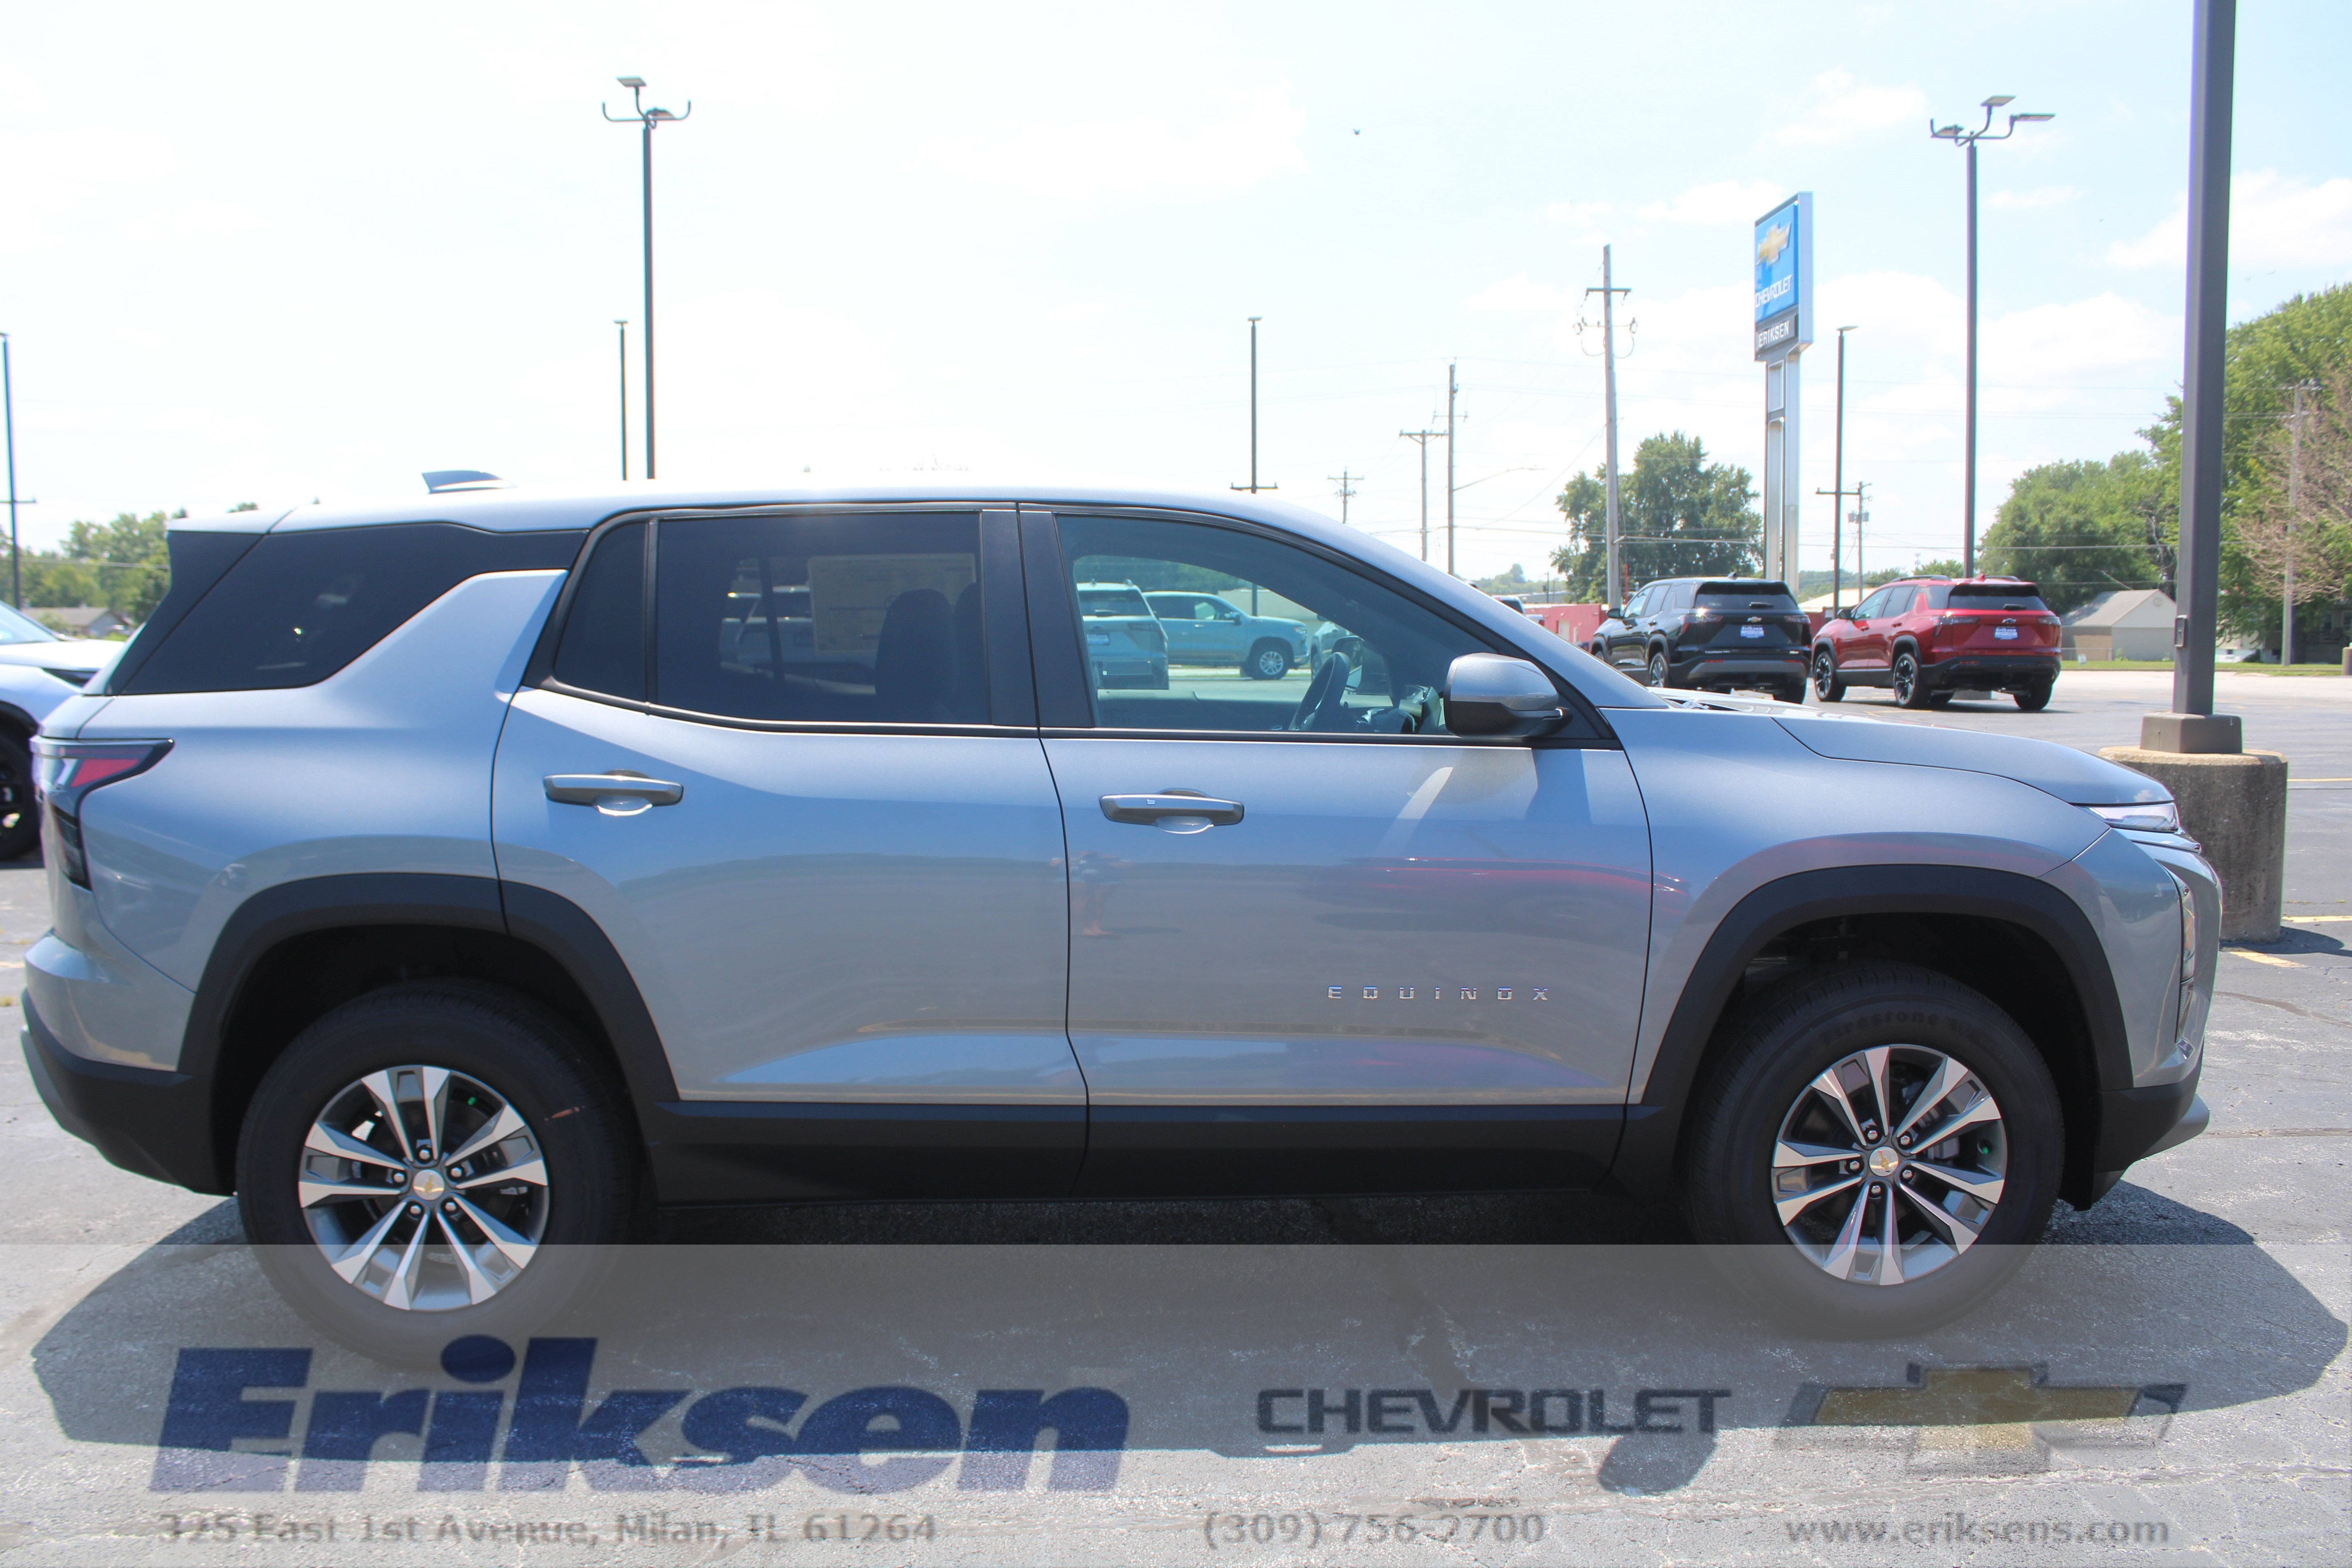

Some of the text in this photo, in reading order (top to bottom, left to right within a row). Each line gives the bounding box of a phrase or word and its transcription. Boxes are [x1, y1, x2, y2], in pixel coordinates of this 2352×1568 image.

[1755, 274, 1793, 308] CHEVROLET
[1759, 320, 1790, 347] ERIKSEN
[1327, 986, 1549, 1000] EQUINOX
